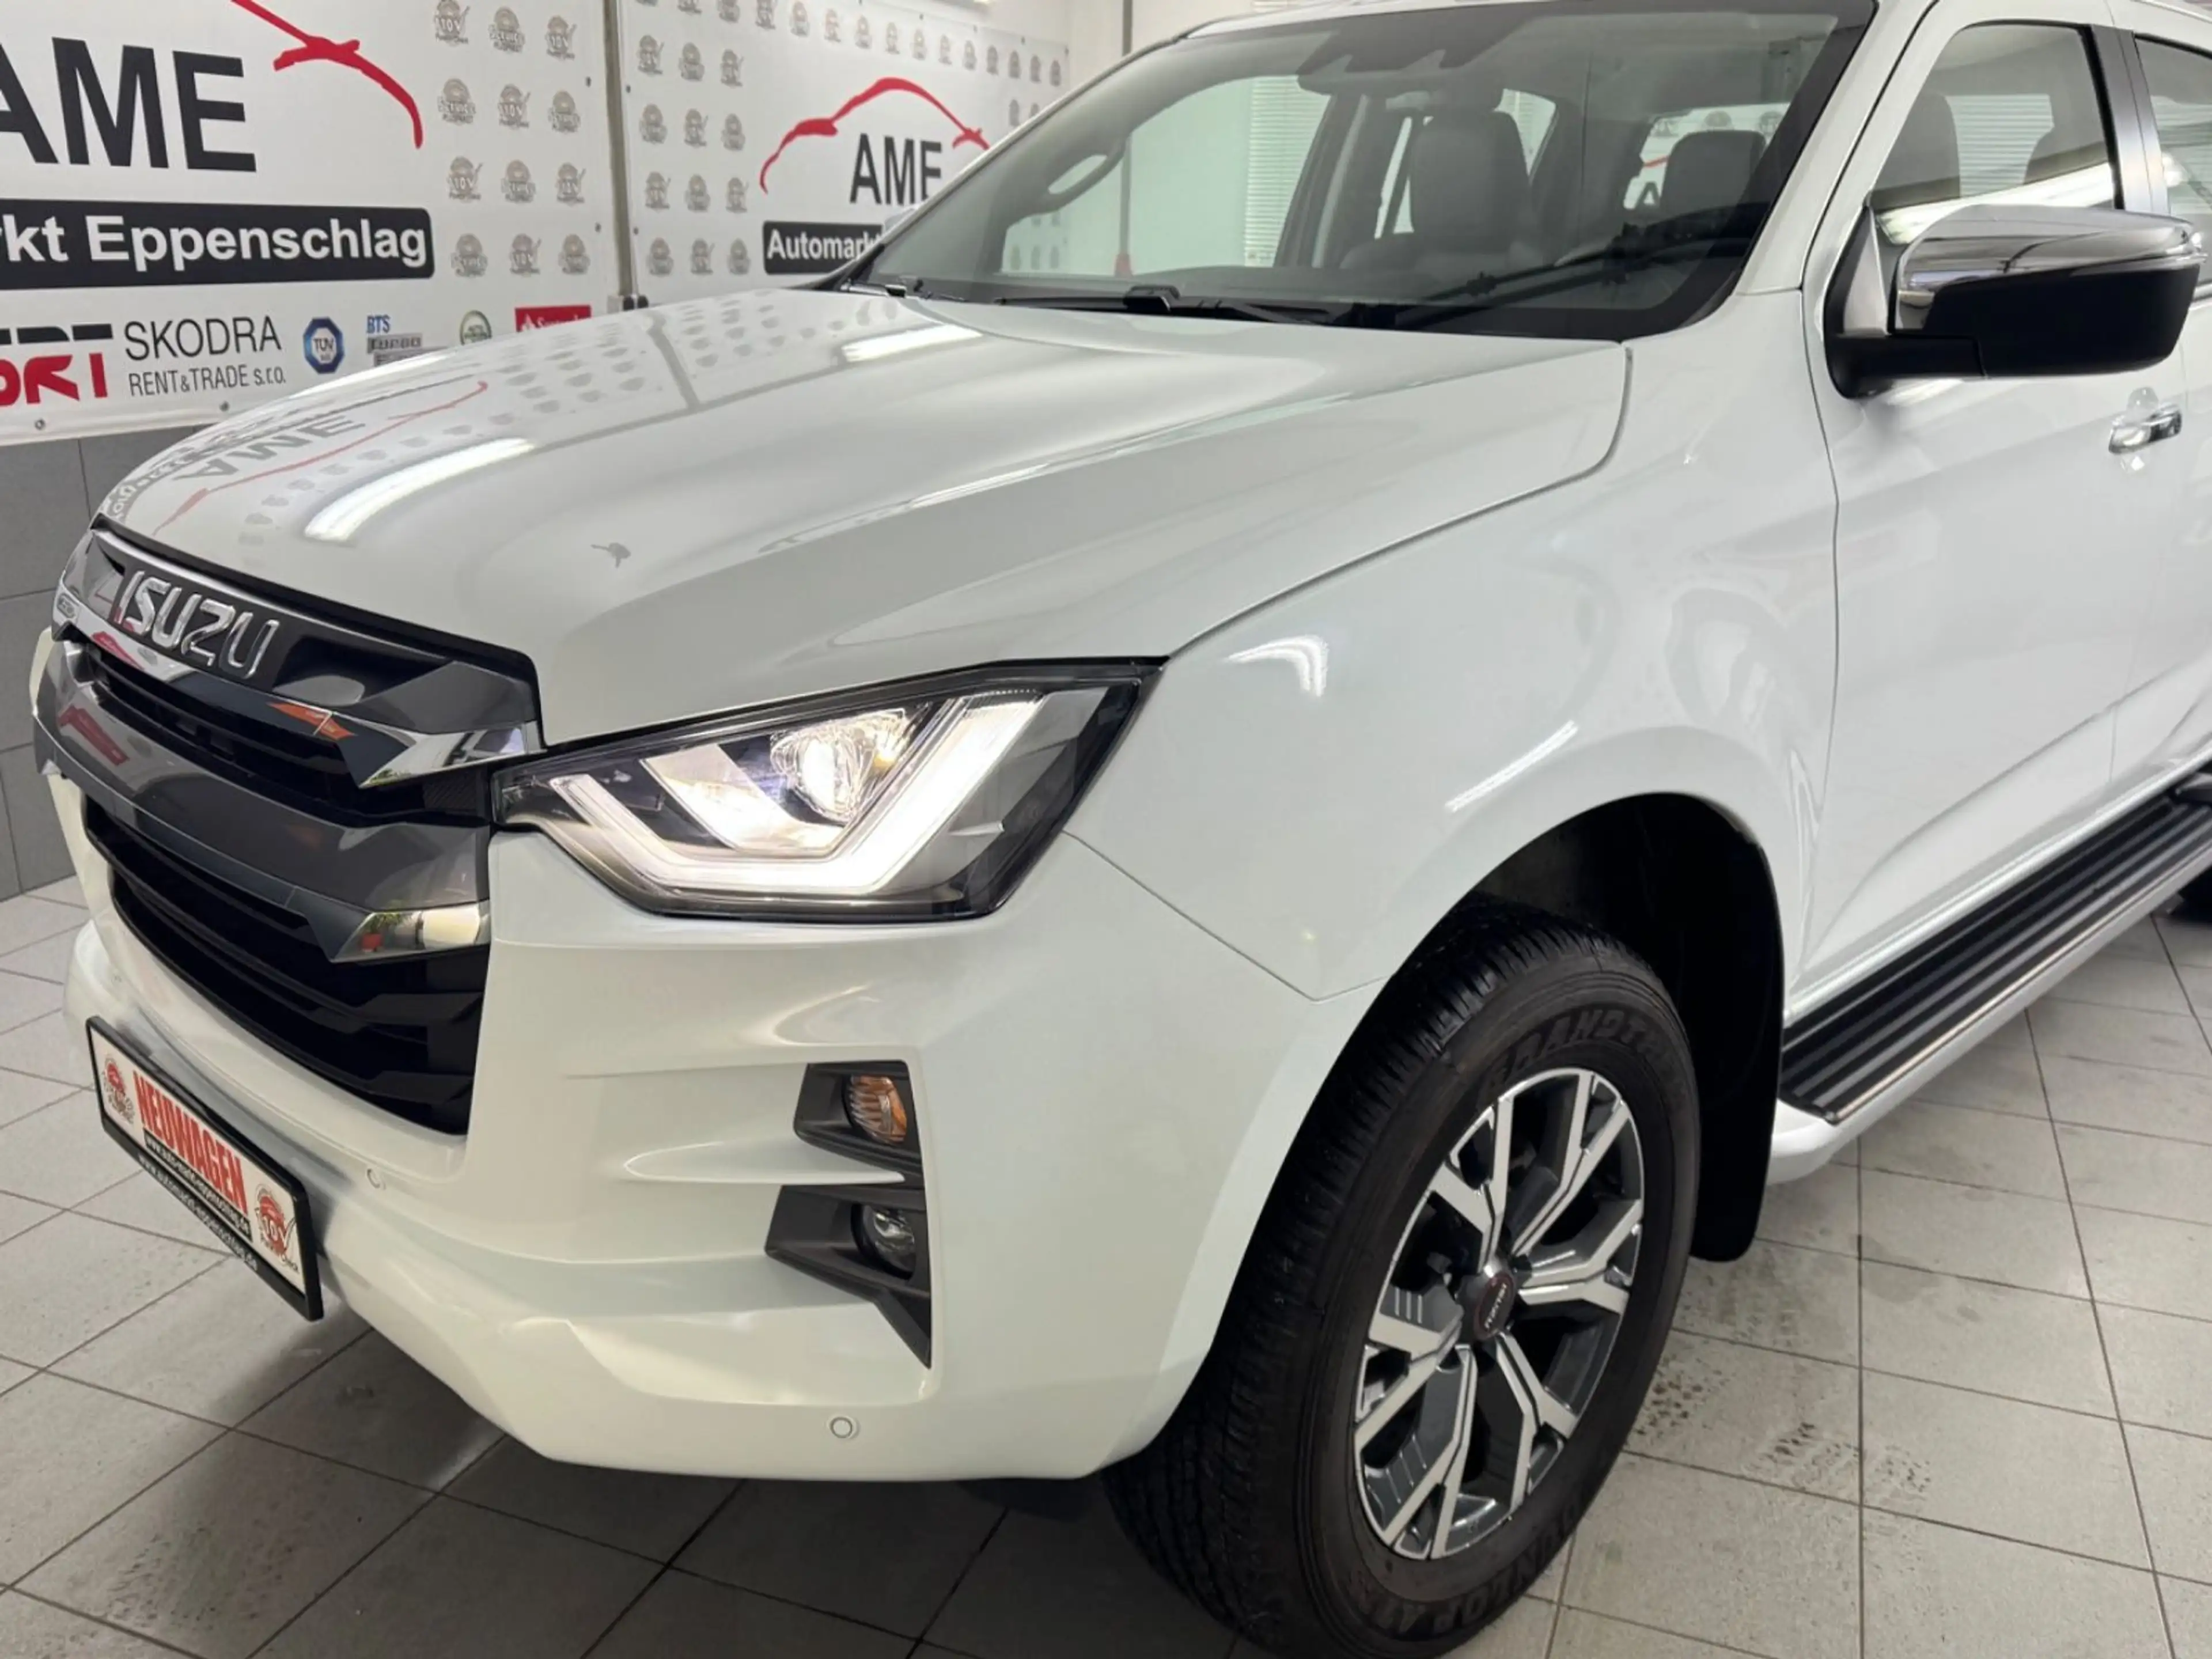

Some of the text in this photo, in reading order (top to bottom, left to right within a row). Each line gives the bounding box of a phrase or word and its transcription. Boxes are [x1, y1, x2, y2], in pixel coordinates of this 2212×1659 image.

[850, 132, 942, 206] AME
[0, 213, 69, 263] kt
[85, 215, 426, 272] Eppenschlag
[767, 229, 882, 260] Automark
[124, 315, 282, 361] SKODRA
[366, 315, 392, 334] BTS
[128, 363, 286, 397] RENT&TRADE s.r.o.
[114, 570, 281, 680] ISUZU
[133, 1070, 248, 1215] NEUWAGEN
